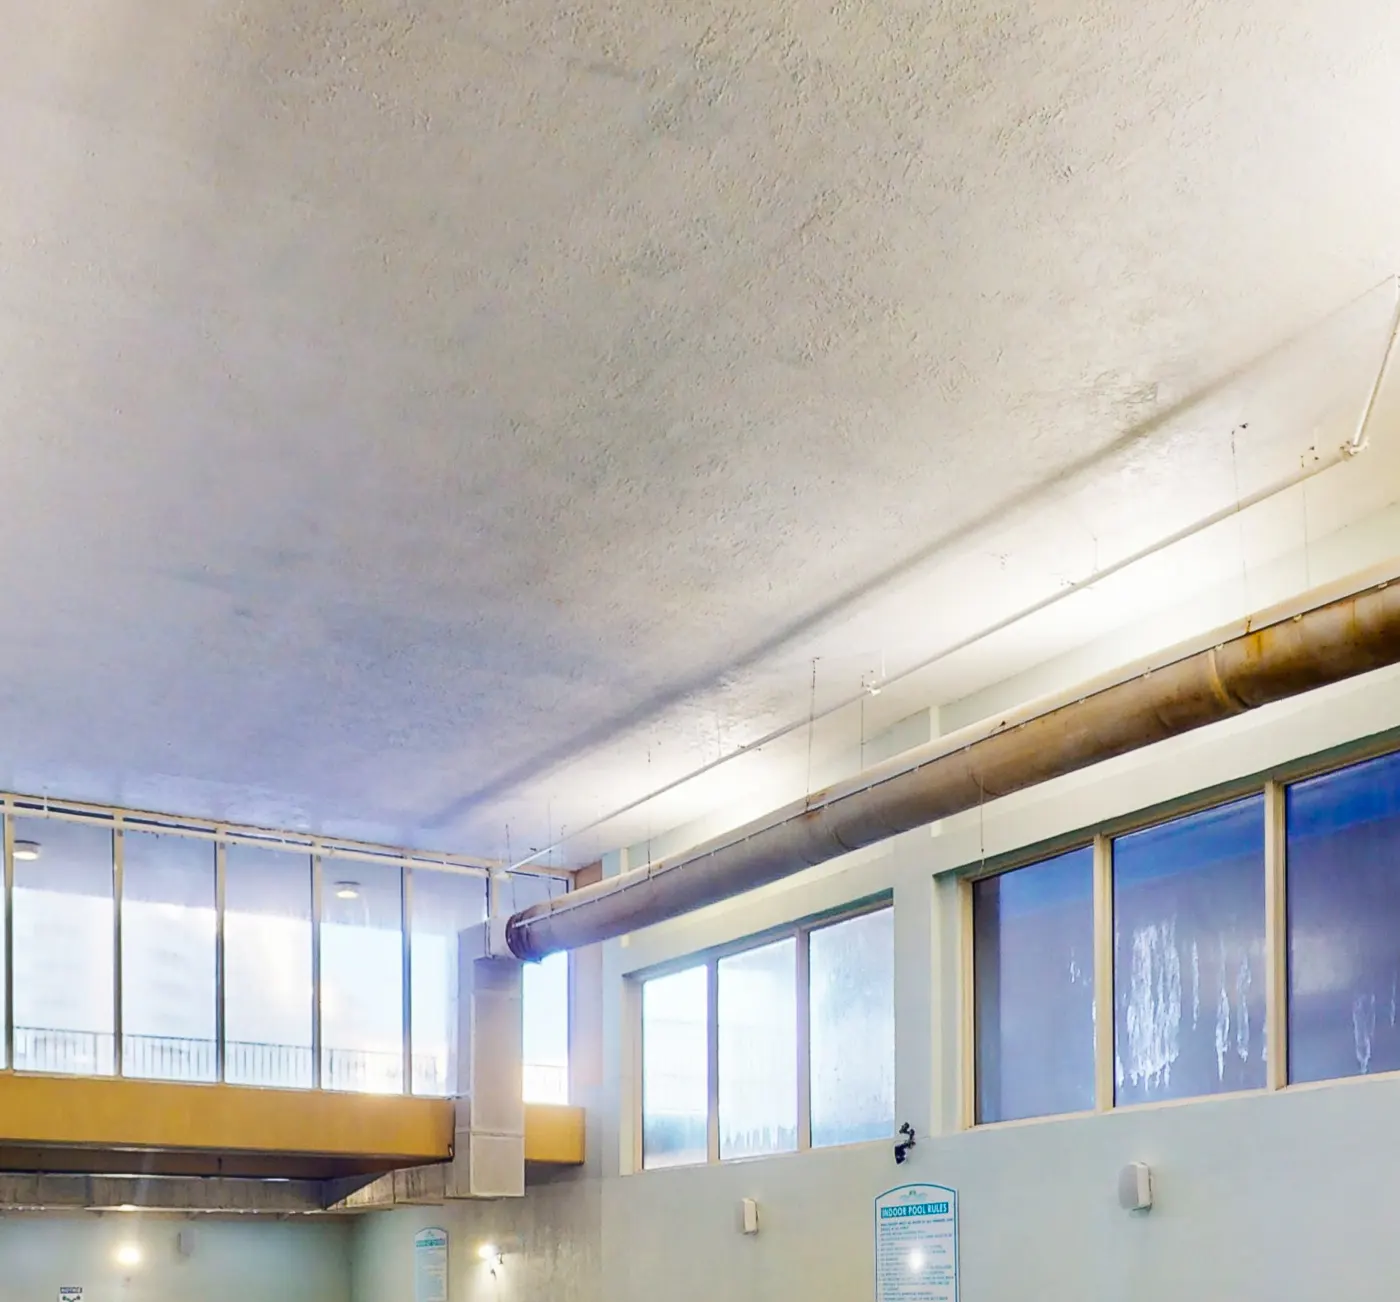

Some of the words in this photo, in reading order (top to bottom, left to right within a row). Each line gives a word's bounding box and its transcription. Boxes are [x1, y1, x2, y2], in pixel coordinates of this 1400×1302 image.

[882, 1208, 906, 1217] INDOOR
[908, 1205, 926, 1215] POOL
[927, 1203, 947, 1213] RULES
